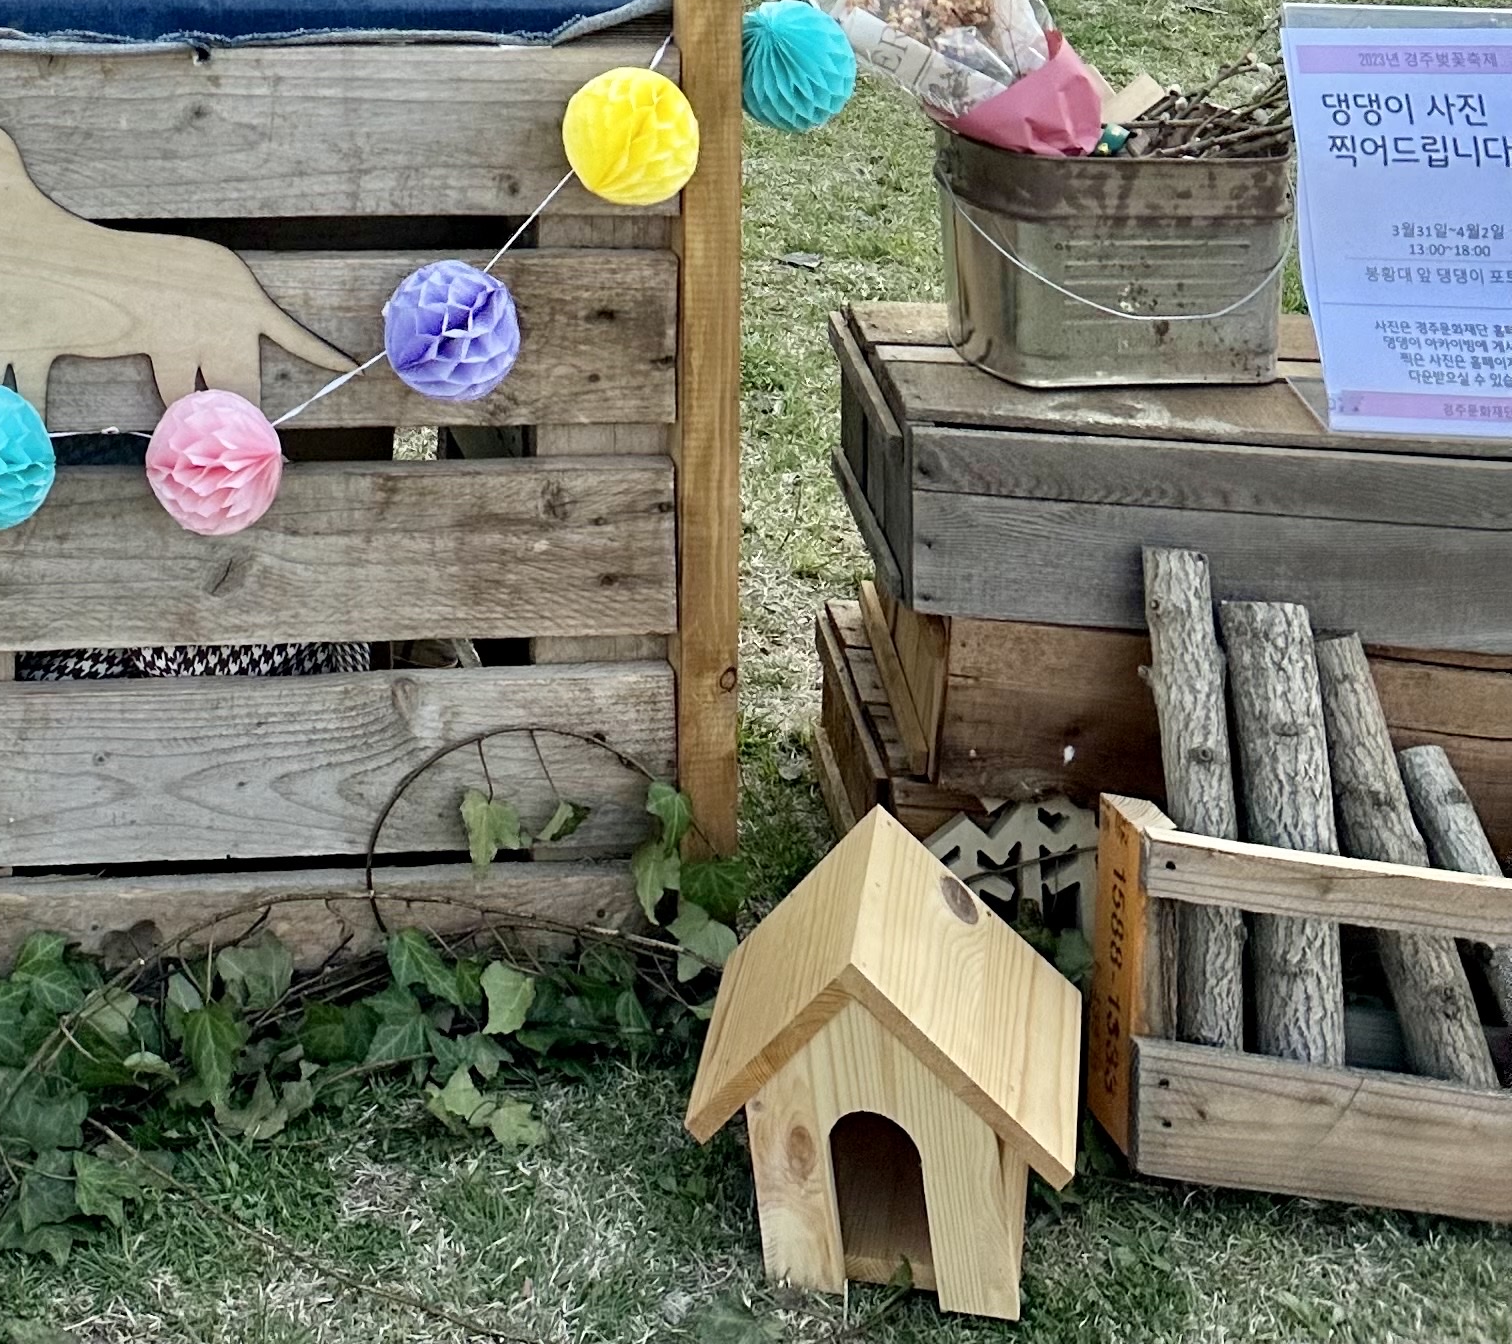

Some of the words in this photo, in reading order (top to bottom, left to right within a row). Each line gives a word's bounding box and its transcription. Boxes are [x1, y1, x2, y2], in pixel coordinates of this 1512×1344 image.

[1358, 51, 1400, 68] 2023년
[1321, 92, 1414, 127] 댕댕이
[1426, 92, 1488, 127] 사진
[1327, 134, 1512, 169] 찍어드립니다
[1365, 266, 1413, 285] 봉황대
[1416, 267, 1432, 284] 앞
[1436, 267, 1485, 286] 댕댕이
[1375, 320, 1412, 334] 사진은
[1383, 335, 1422, 350] 댕댕이
[1429, 353, 1467, 369] 사진은
